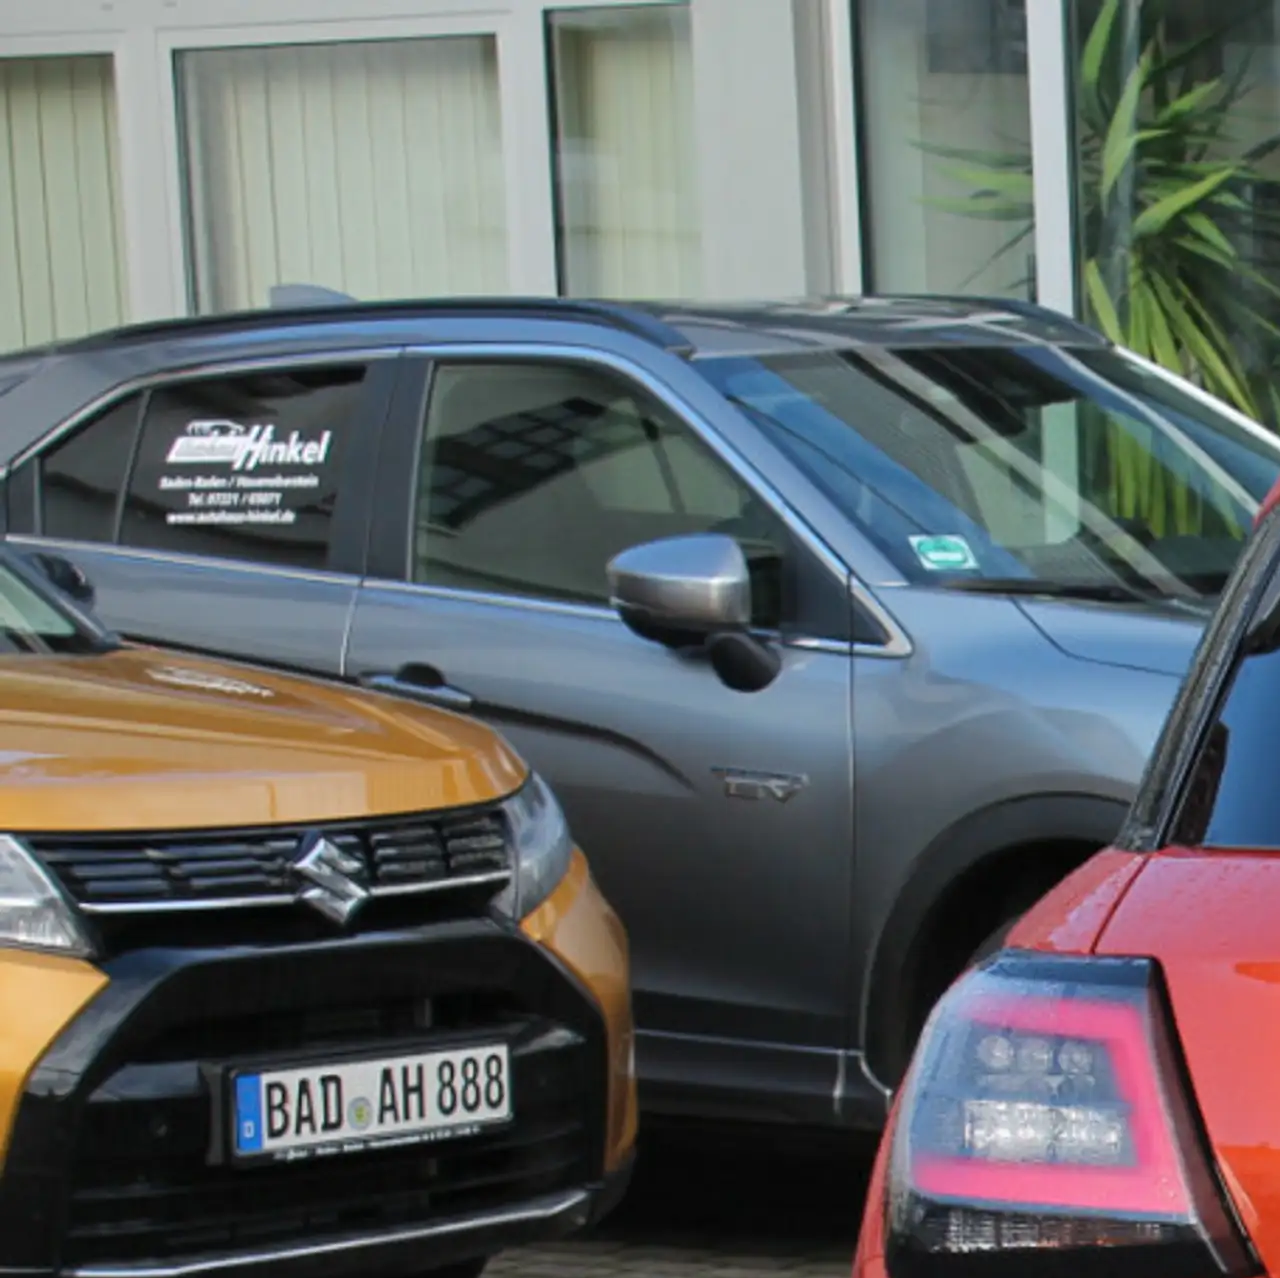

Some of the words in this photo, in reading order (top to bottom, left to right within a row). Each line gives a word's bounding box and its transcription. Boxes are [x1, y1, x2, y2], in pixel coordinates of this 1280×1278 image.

[232, 424, 332, 470] Hinkel
[266, 1074, 342, 1138] BAD
[378, 1063, 425, 1124] AH
[437, 1053, 504, 1116] 888
